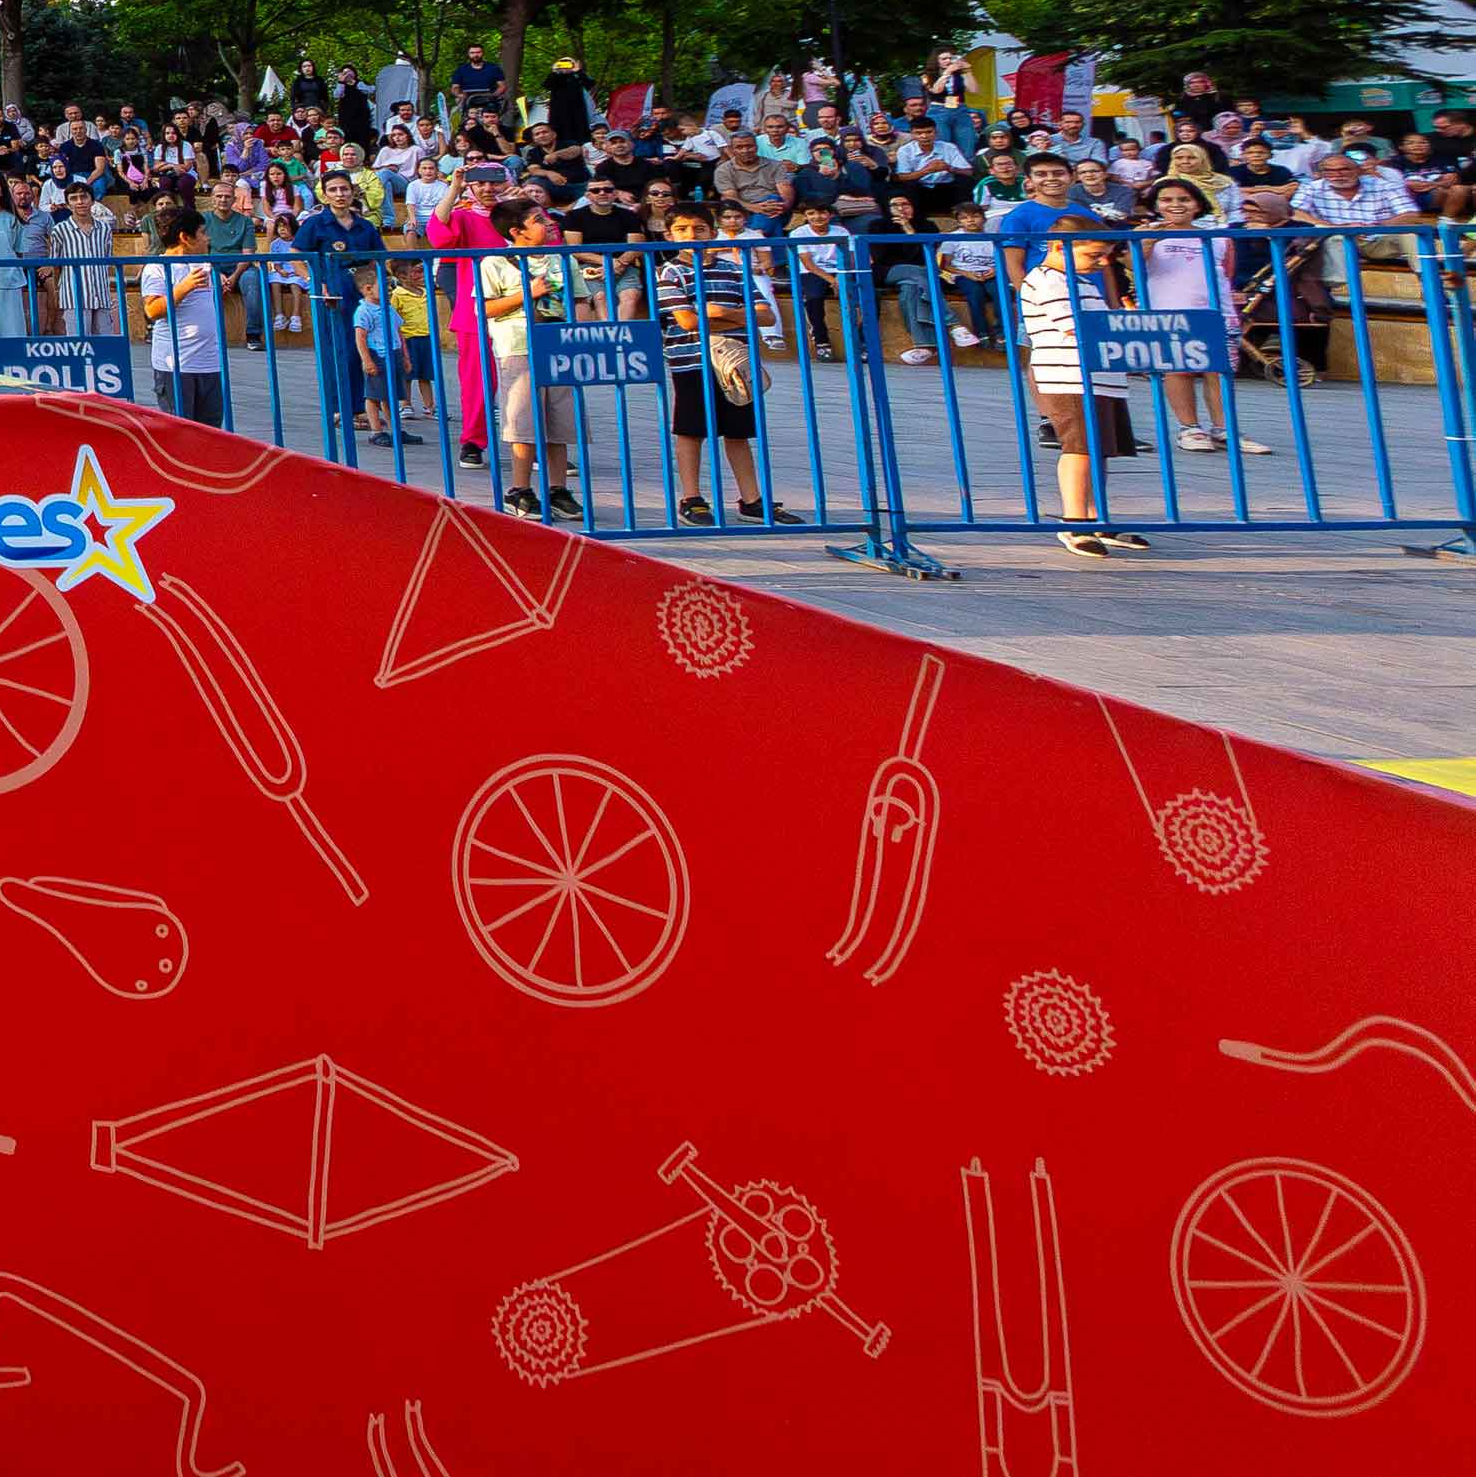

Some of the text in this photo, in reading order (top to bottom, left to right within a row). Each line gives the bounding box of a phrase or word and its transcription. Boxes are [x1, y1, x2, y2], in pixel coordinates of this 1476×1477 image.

[1108, 314, 1190, 332] KONYA
[560, 326, 633, 343] KONYA
[26, 342, 95, 357] KONYA
[1098, 333, 1210, 370] POLİS
[550, 346, 649, 381] POLİS
